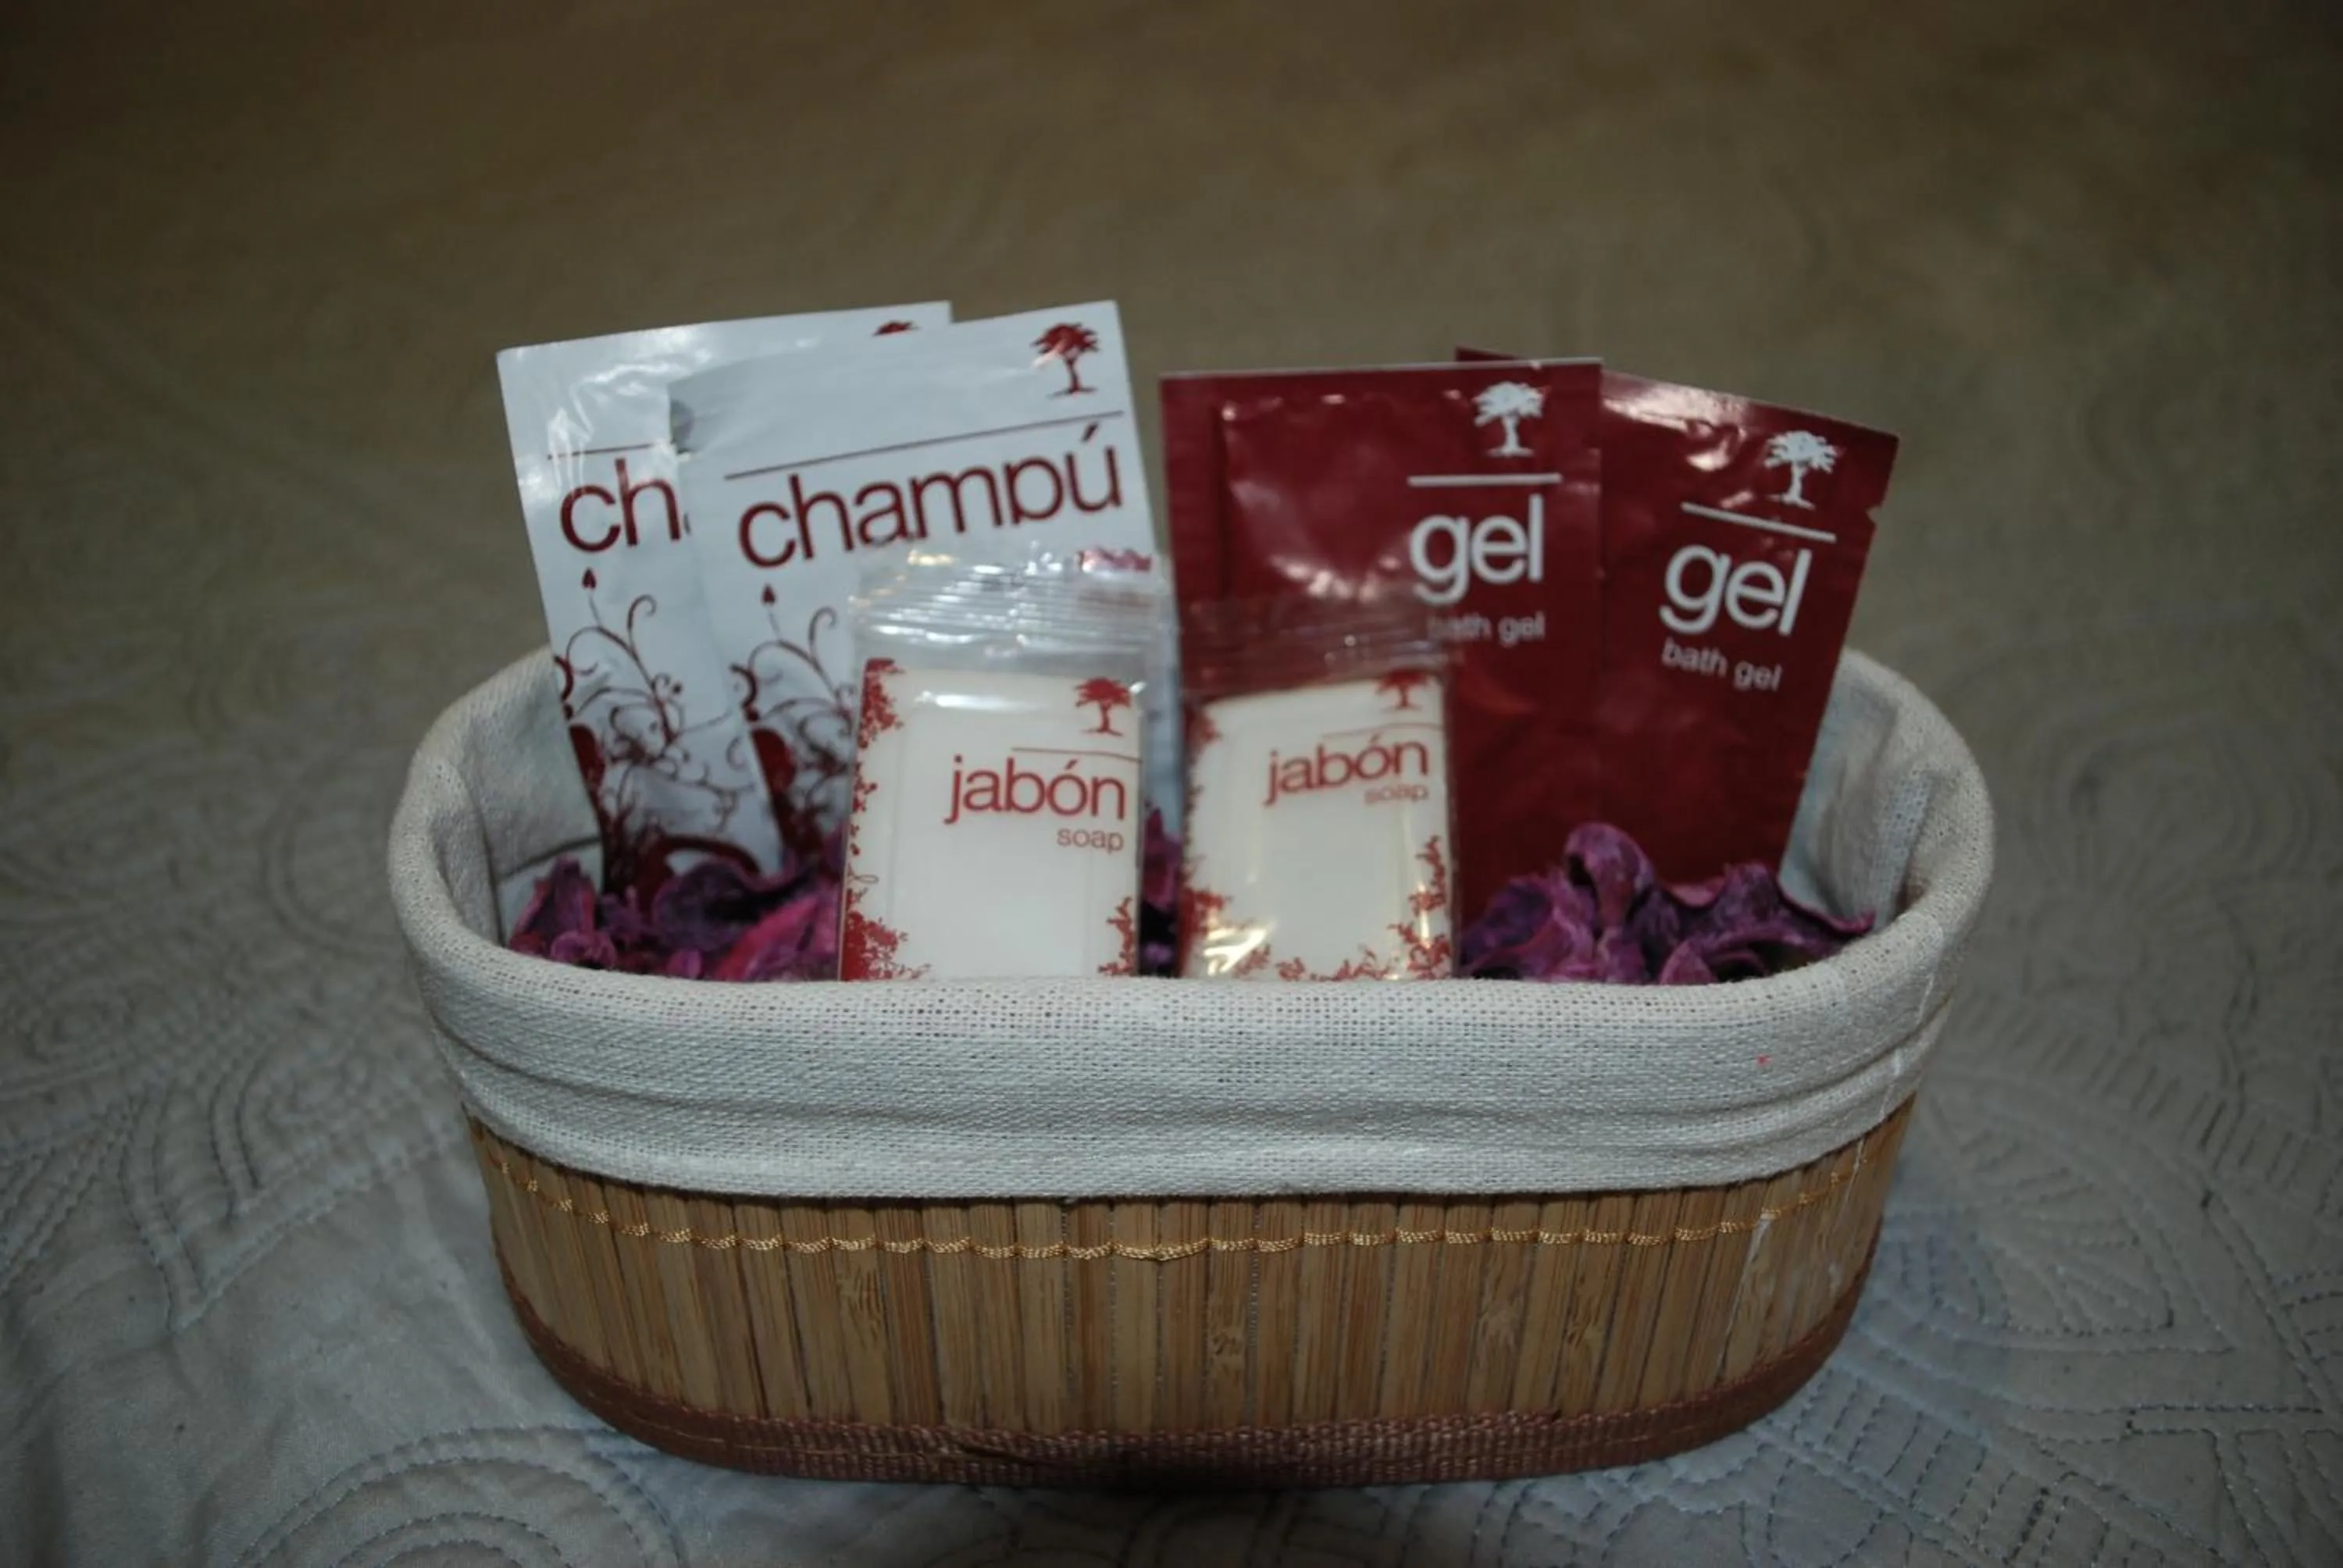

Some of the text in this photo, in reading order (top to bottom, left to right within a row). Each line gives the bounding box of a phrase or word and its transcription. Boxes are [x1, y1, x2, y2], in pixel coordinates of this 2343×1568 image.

[560, 458, 691, 554] ch
[736, 425, 1123, 569] champú
[1409, 493, 1544, 604] gel
[1659, 544, 1812, 636] gel
[1497, 611, 1546, 648] gel
[1661, 636, 1783, 692] bath gel
[944, 754, 1125, 825] jabón
[1263, 732, 1428, 807] jabón
[1056, 826, 1124, 853] soap
